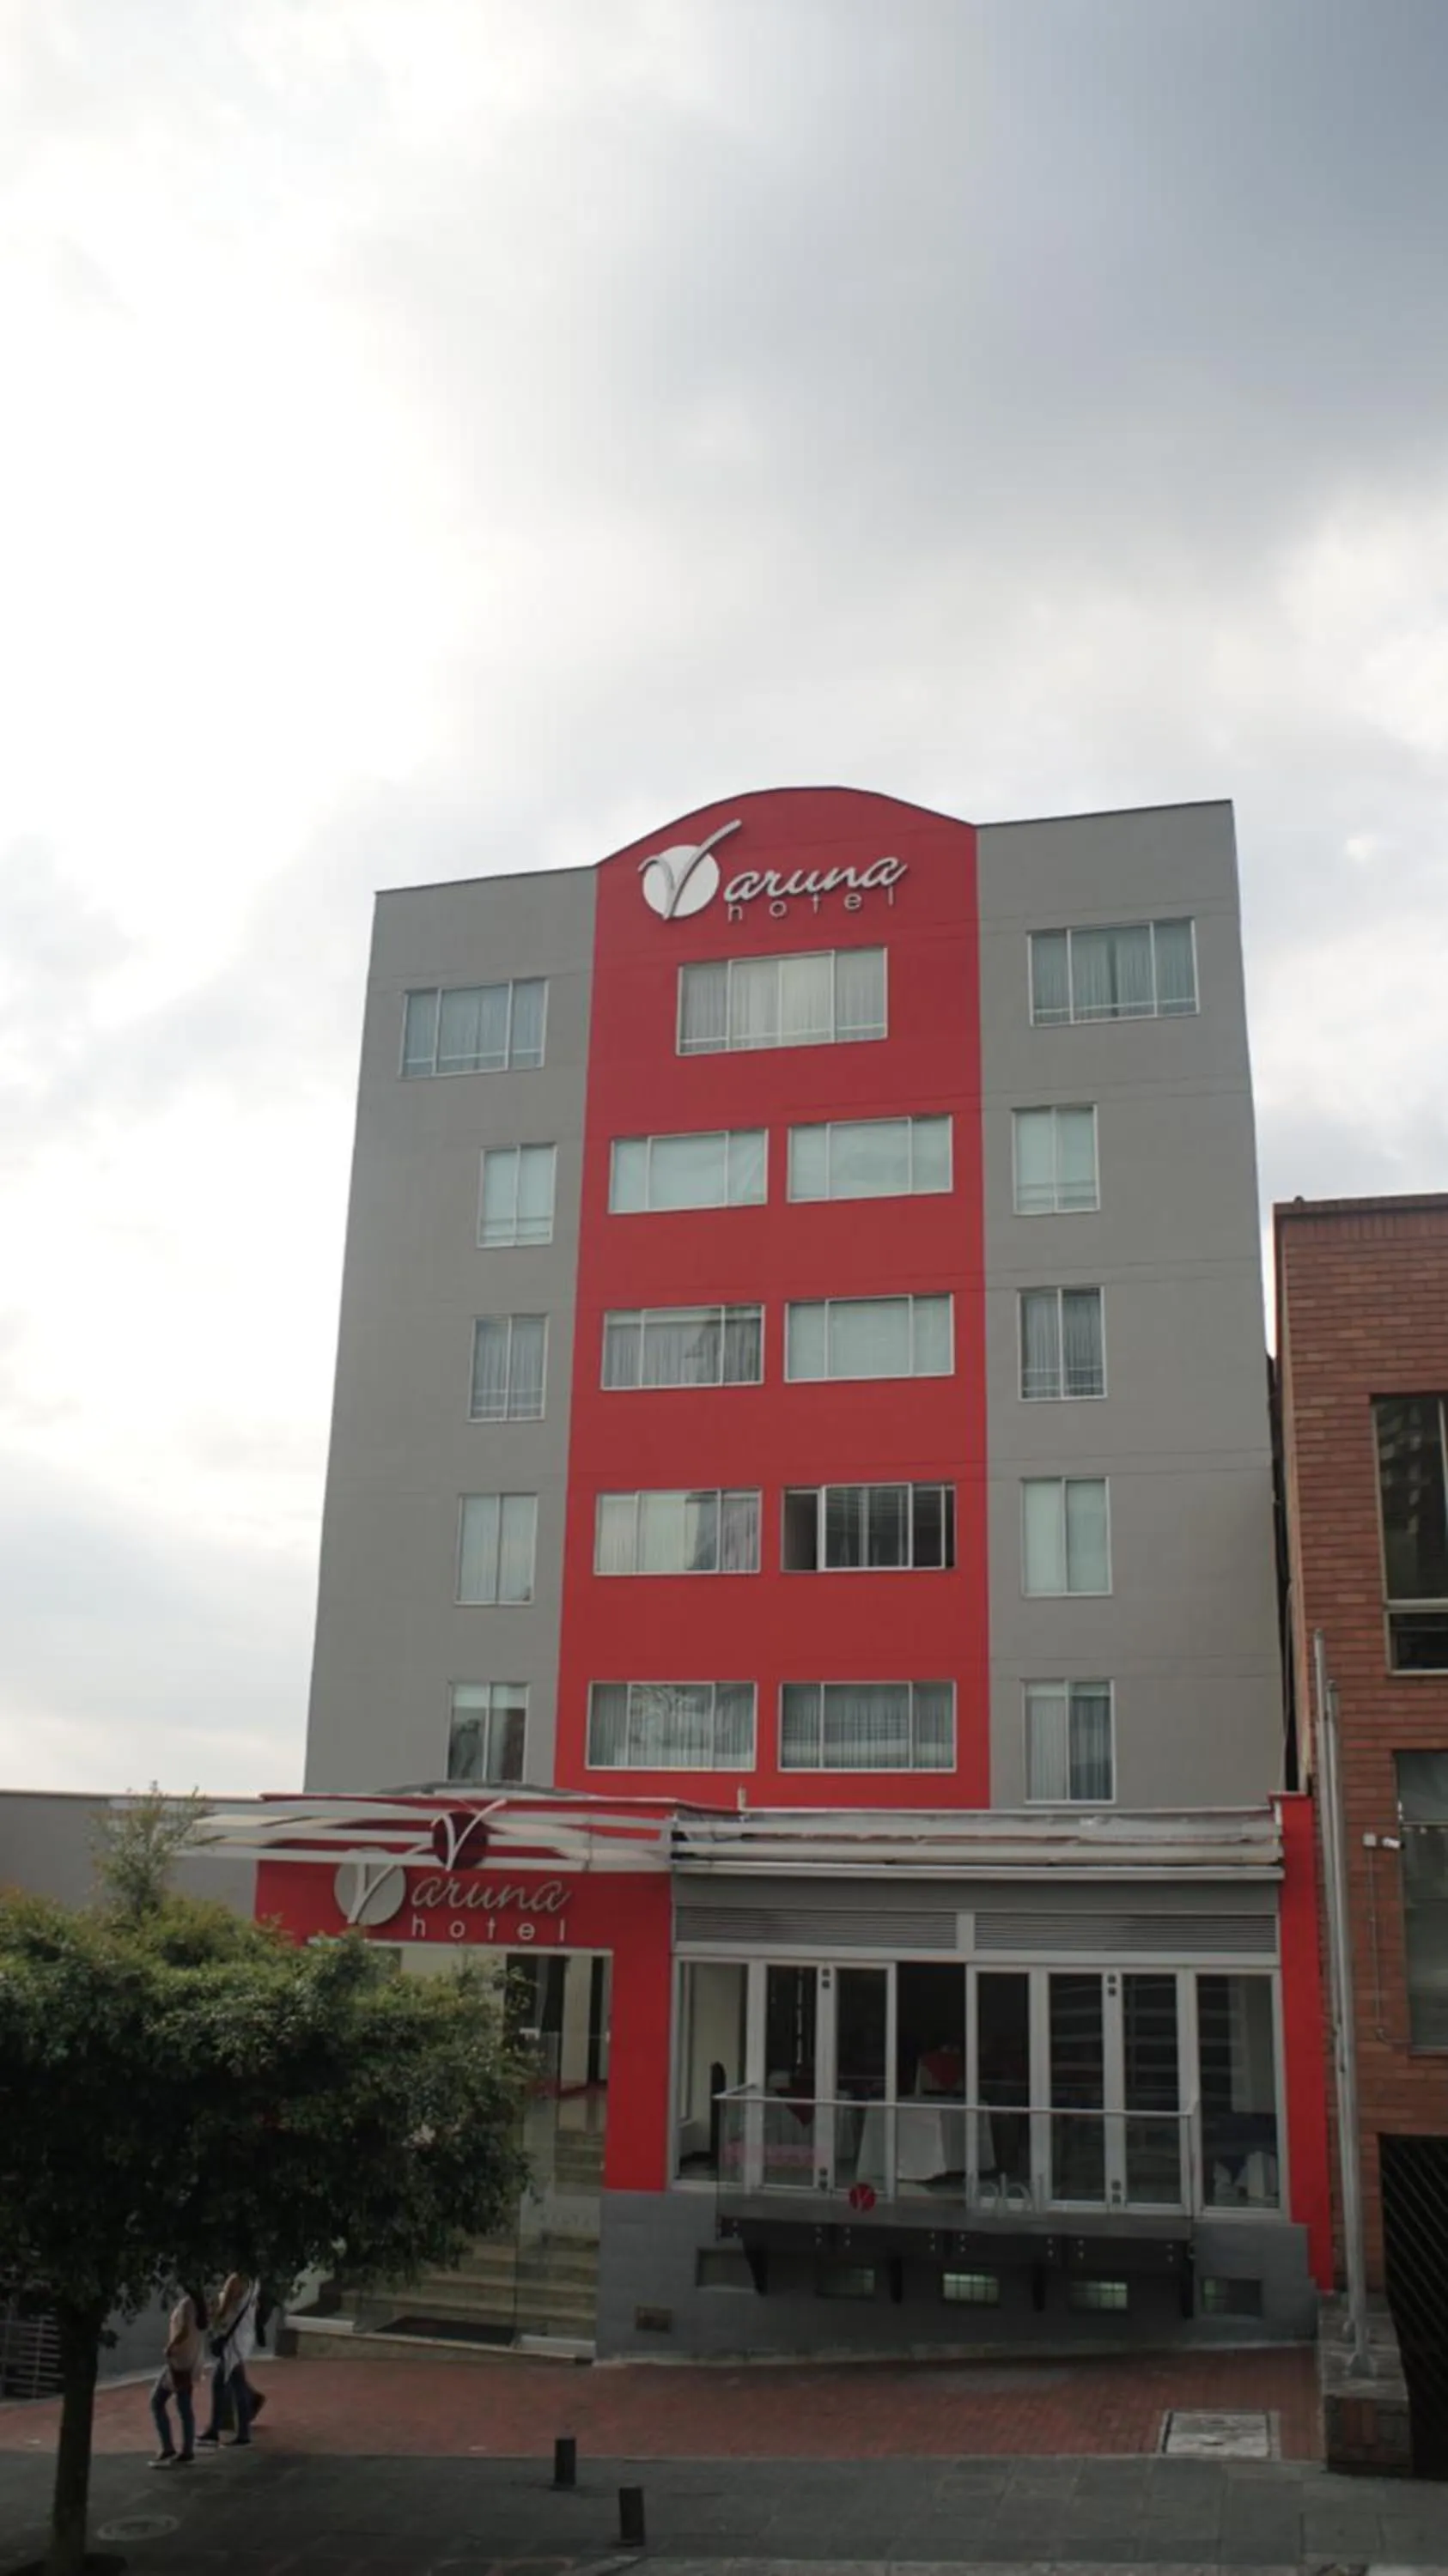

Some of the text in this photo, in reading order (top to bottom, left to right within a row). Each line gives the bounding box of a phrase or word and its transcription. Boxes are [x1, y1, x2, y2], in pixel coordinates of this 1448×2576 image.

[638, 819, 907, 920] Varuna
[728, 885, 894, 921] hotel
[337, 1844, 571, 1925] Varuna
[411, 1914, 566, 1941] hotel
